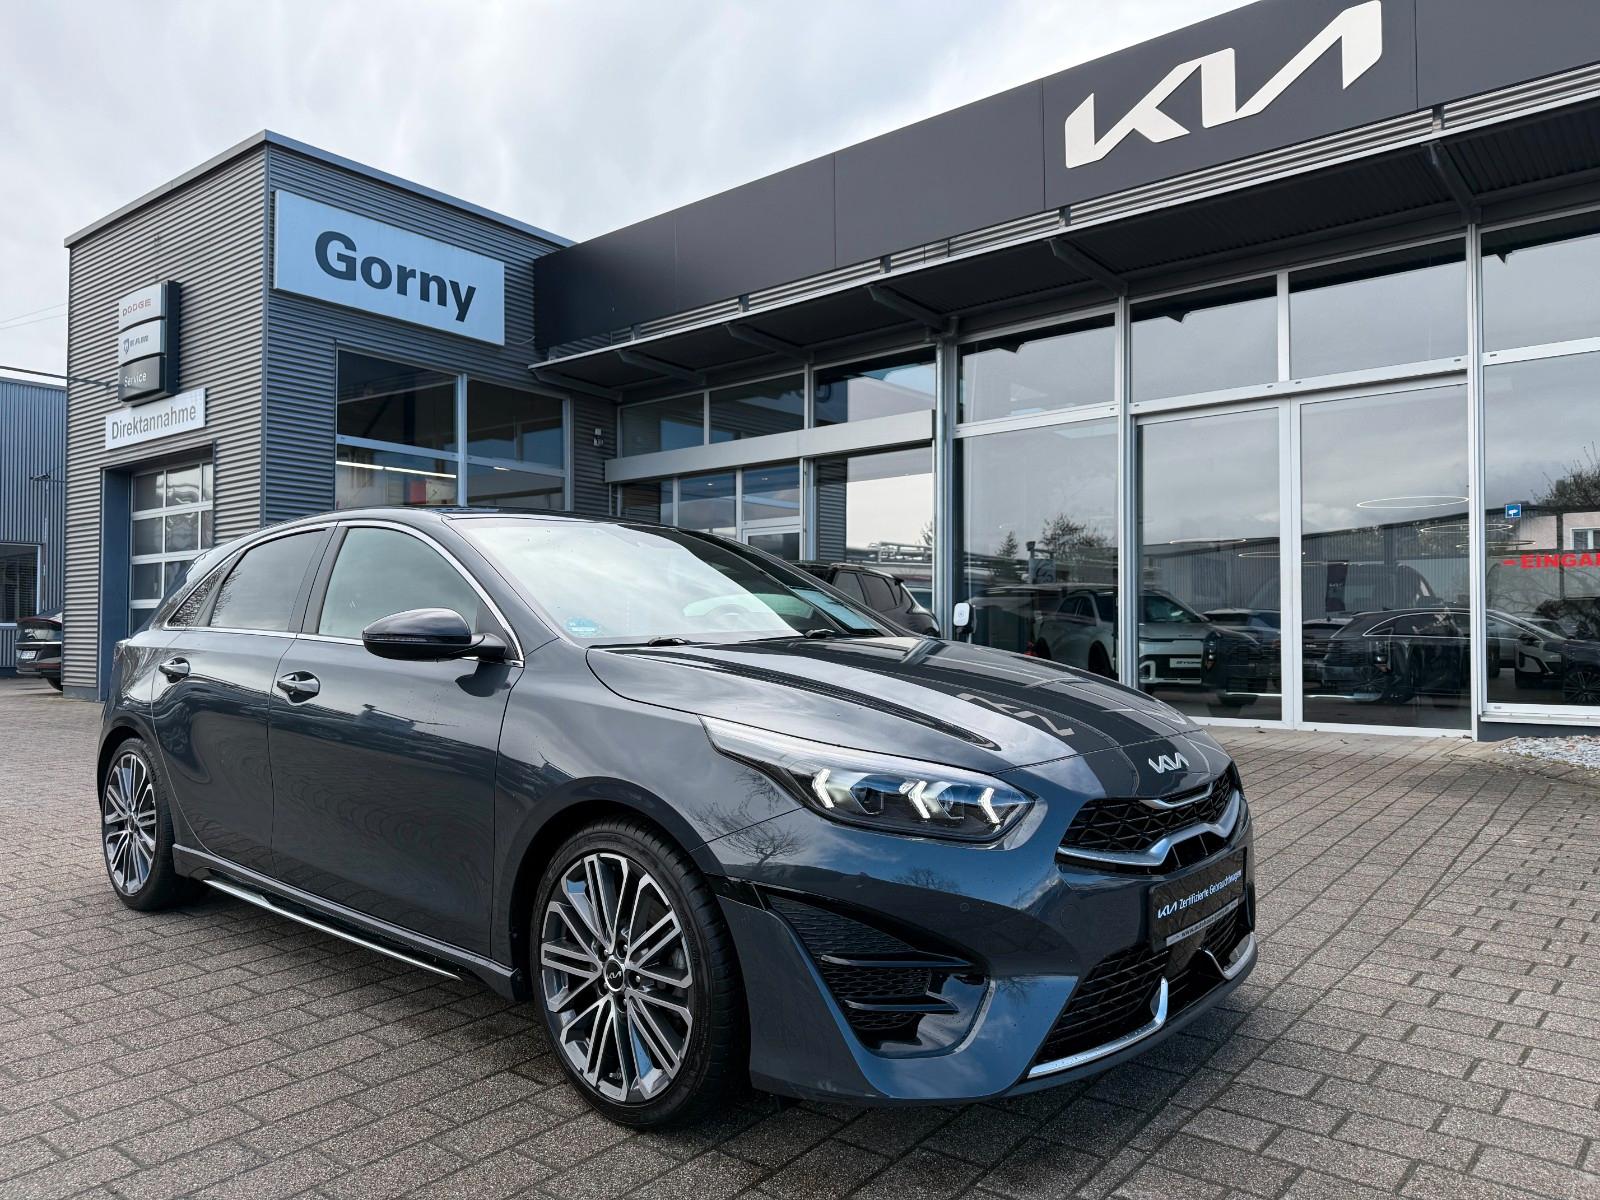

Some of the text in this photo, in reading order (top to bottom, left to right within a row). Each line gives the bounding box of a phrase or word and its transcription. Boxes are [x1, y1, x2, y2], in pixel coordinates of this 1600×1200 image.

[314, 230, 477, 323] Gorny
[122, 298, 152, 317] DODGE
[124, 371, 147, 388] Service
[111, 404, 197, 440] Direktannahme
